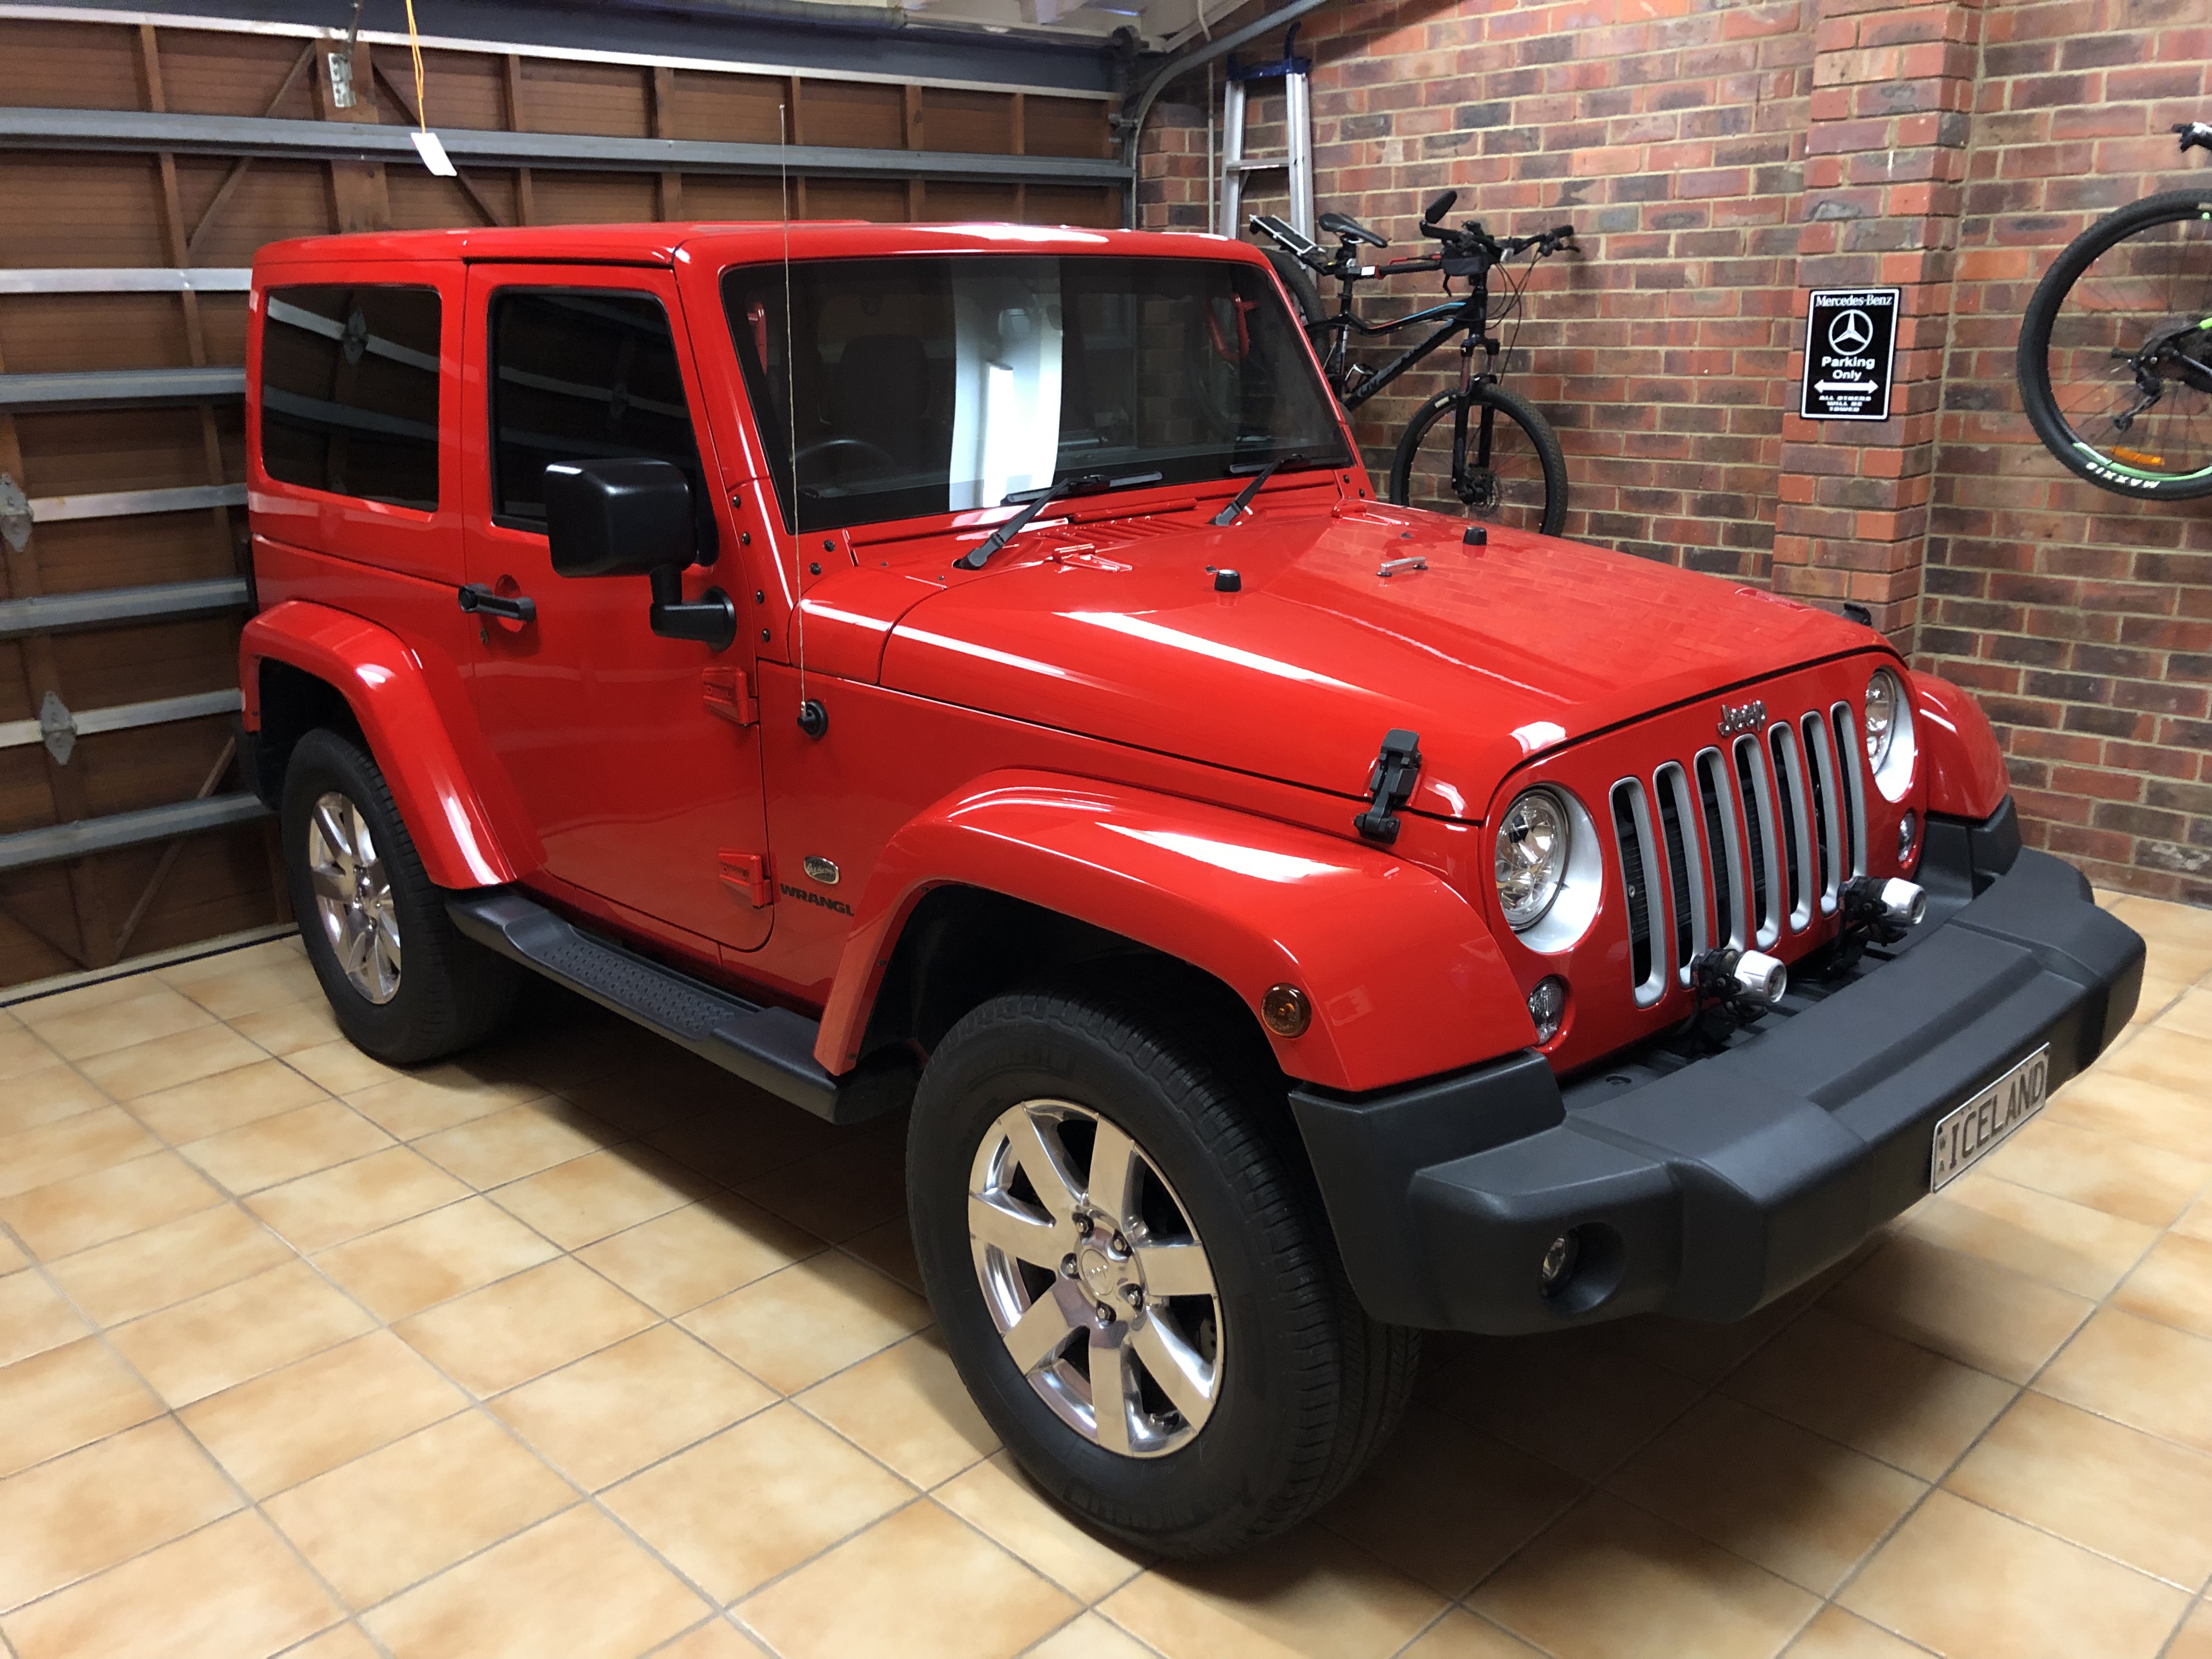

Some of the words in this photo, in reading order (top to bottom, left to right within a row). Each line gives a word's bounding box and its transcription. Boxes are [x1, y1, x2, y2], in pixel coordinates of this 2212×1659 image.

[1815, 295, 1893, 307] Mercedes-Benz
[1821, 356, 1876, 370] Parking
[1832, 369, 1862, 381] Only
[2086, 462, 2160, 489] MAXXIS
[1718, 700, 1768, 737] Jeep
[1949, 1060, 2045, 1170] ICELAND
